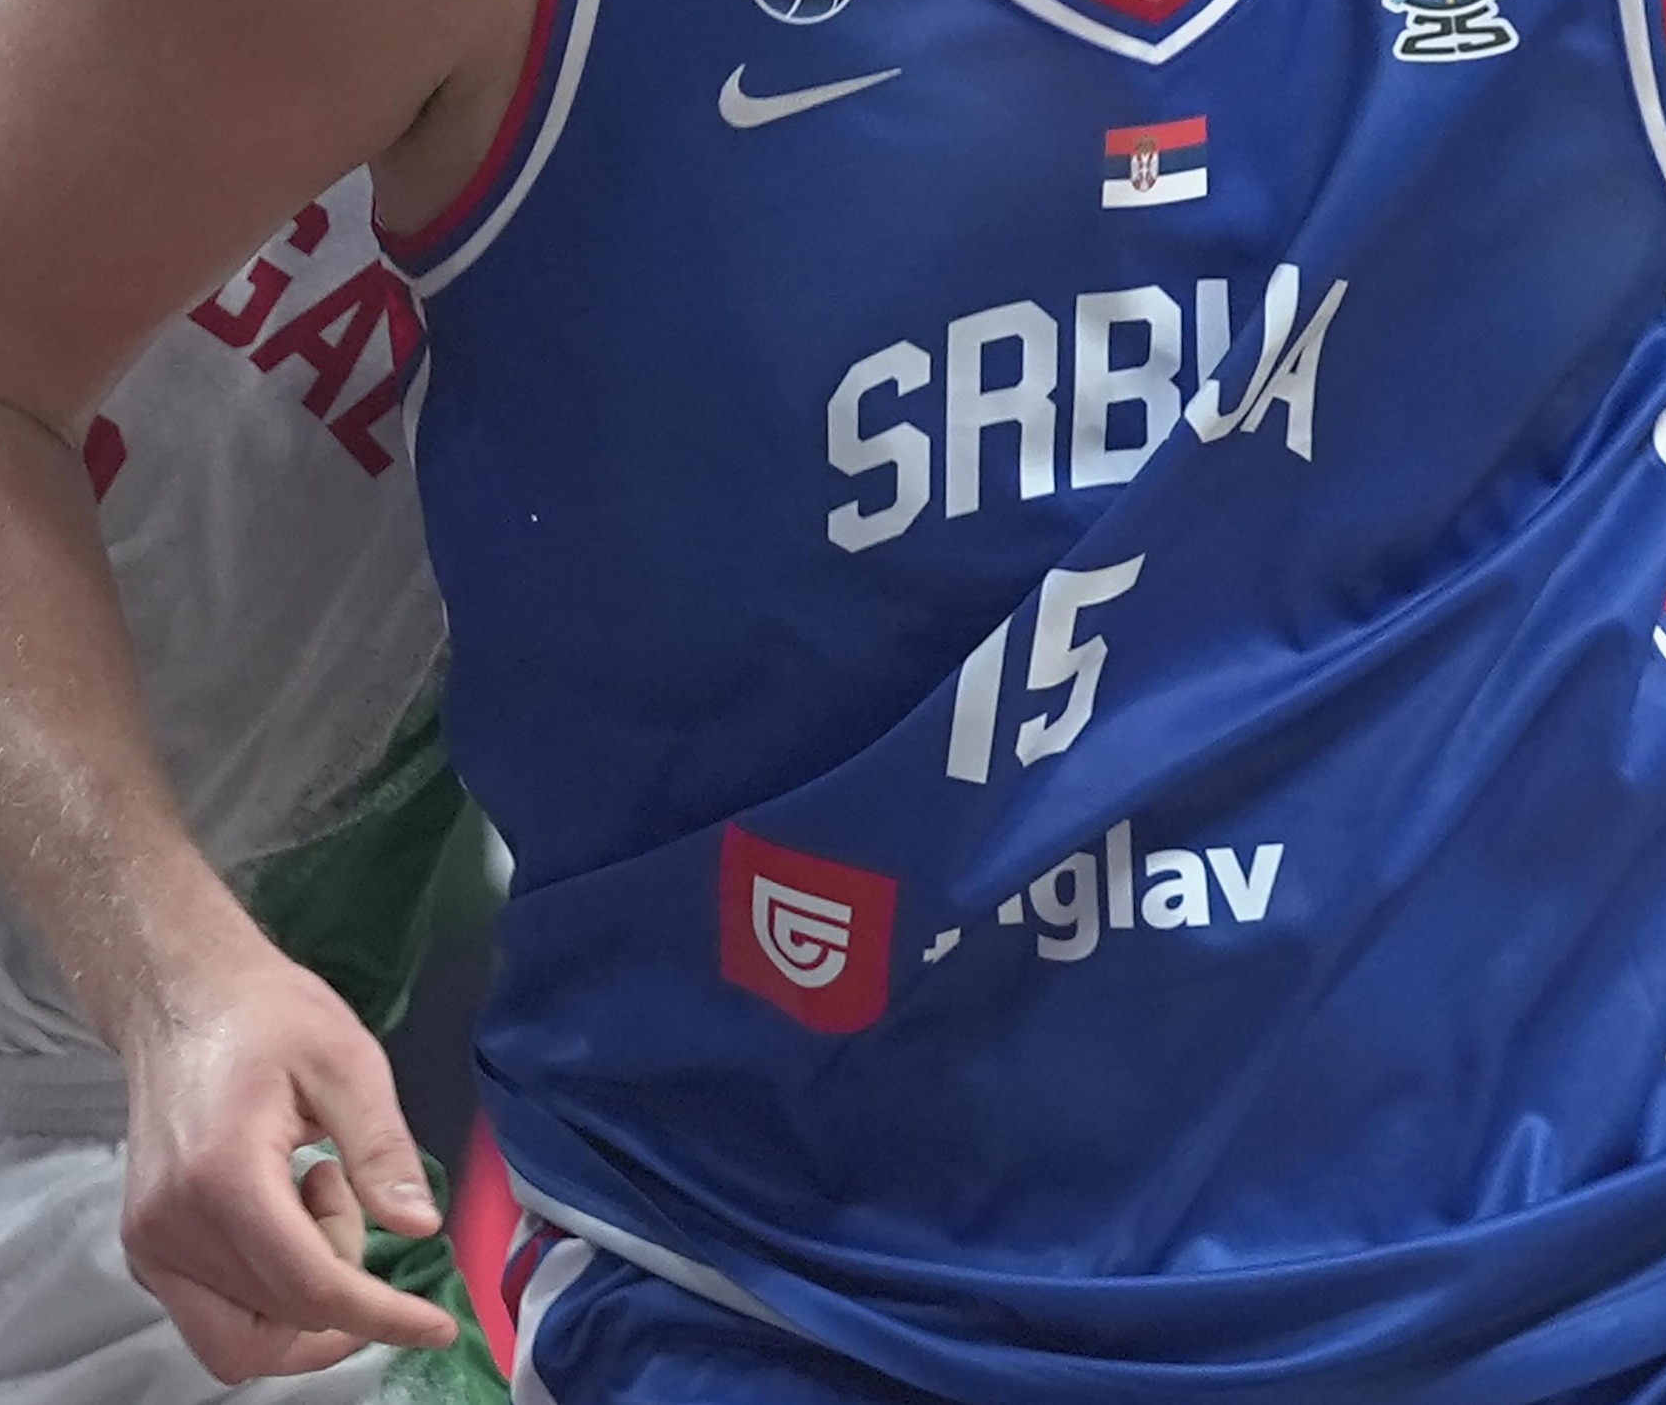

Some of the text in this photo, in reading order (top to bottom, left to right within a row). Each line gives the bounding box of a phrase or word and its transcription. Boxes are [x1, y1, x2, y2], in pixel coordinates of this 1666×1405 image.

[1400, 5, 1512, 55] 25
[827, 263, 1348, 554] SRBIJA
[946, 552, 1146, 784] 15
